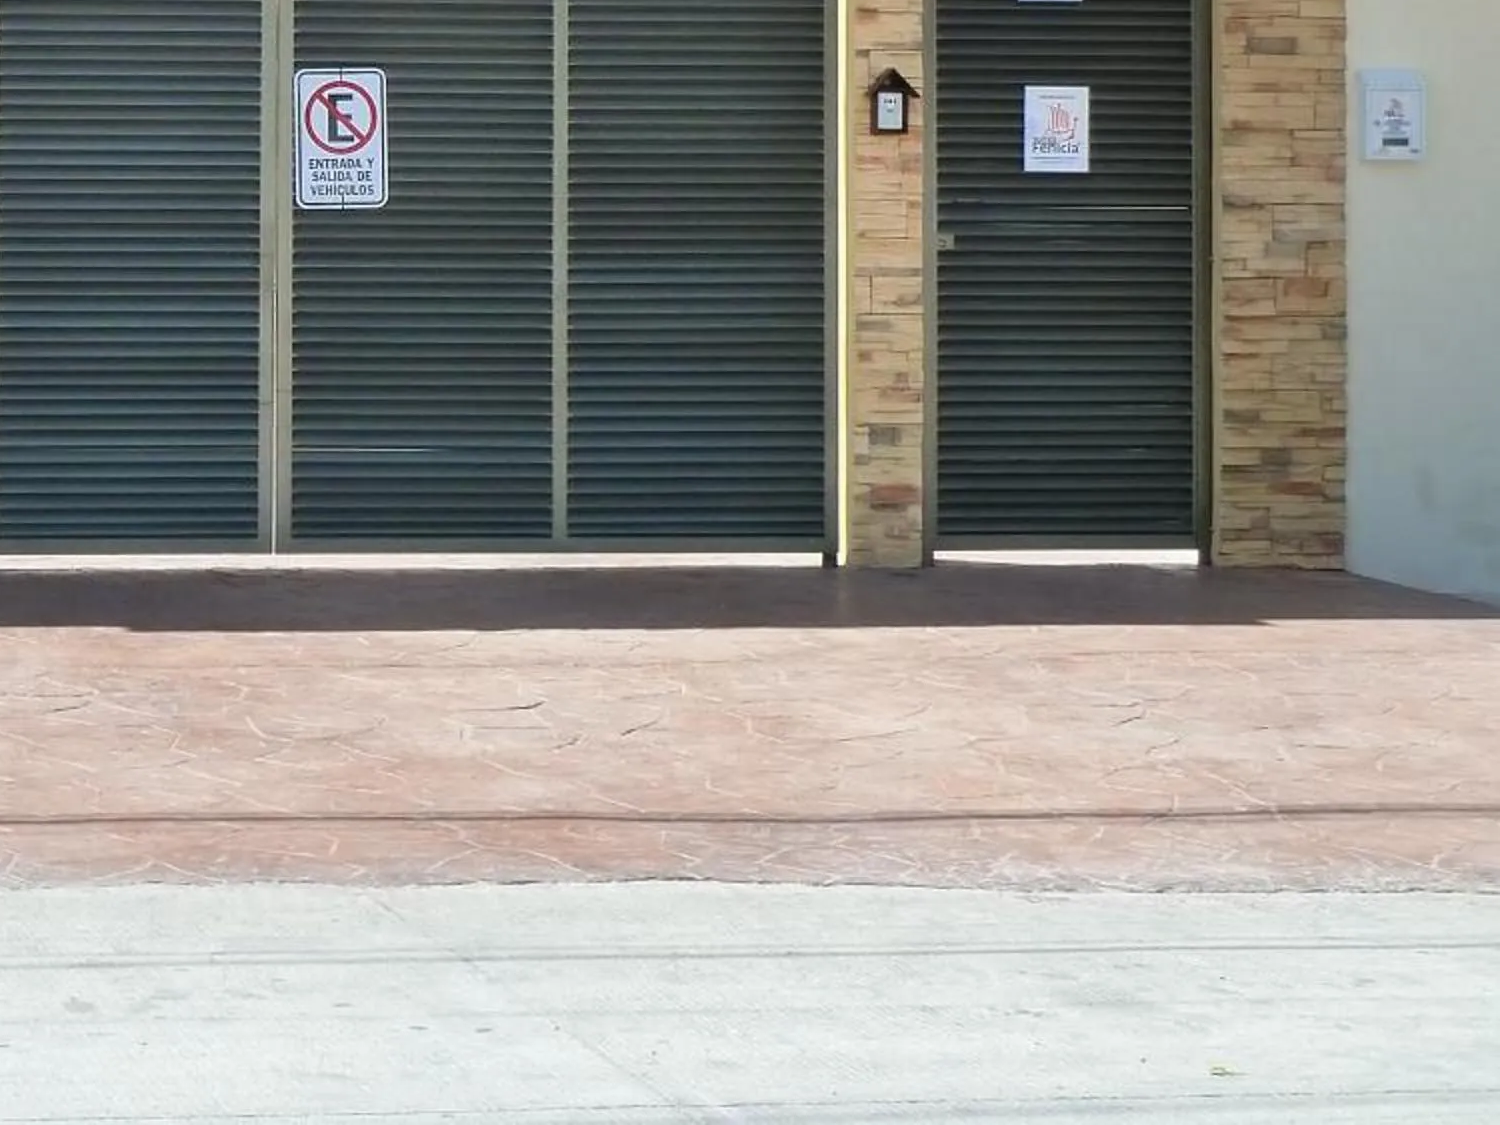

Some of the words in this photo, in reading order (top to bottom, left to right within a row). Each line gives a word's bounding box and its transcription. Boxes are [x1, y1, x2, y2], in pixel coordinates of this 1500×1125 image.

[308, 158, 362, 170] ENTRADA
[367, 158, 375, 170] Y
[311, 171, 353, 182] SALIDA
[357, 171, 373, 182] DE
